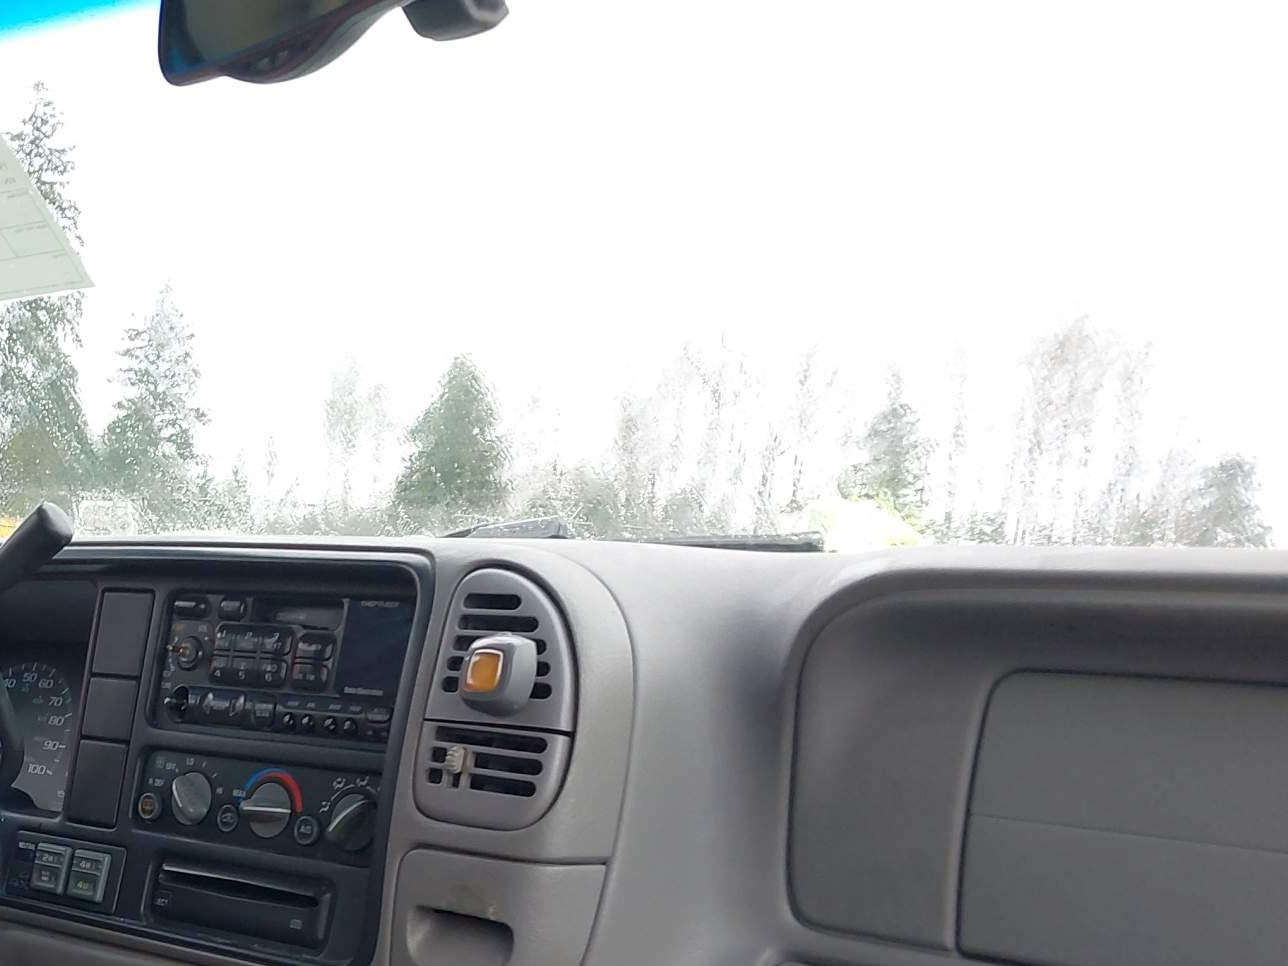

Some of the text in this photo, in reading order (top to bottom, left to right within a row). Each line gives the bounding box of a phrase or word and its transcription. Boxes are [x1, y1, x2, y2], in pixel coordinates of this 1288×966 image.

[38, 678, 54, 689] 60
[48, 696, 63, 706] 70
[48, 715, 65, 727] 80
[42, 740, 59, 751] 90
[28, 763, 47, 776] 100
